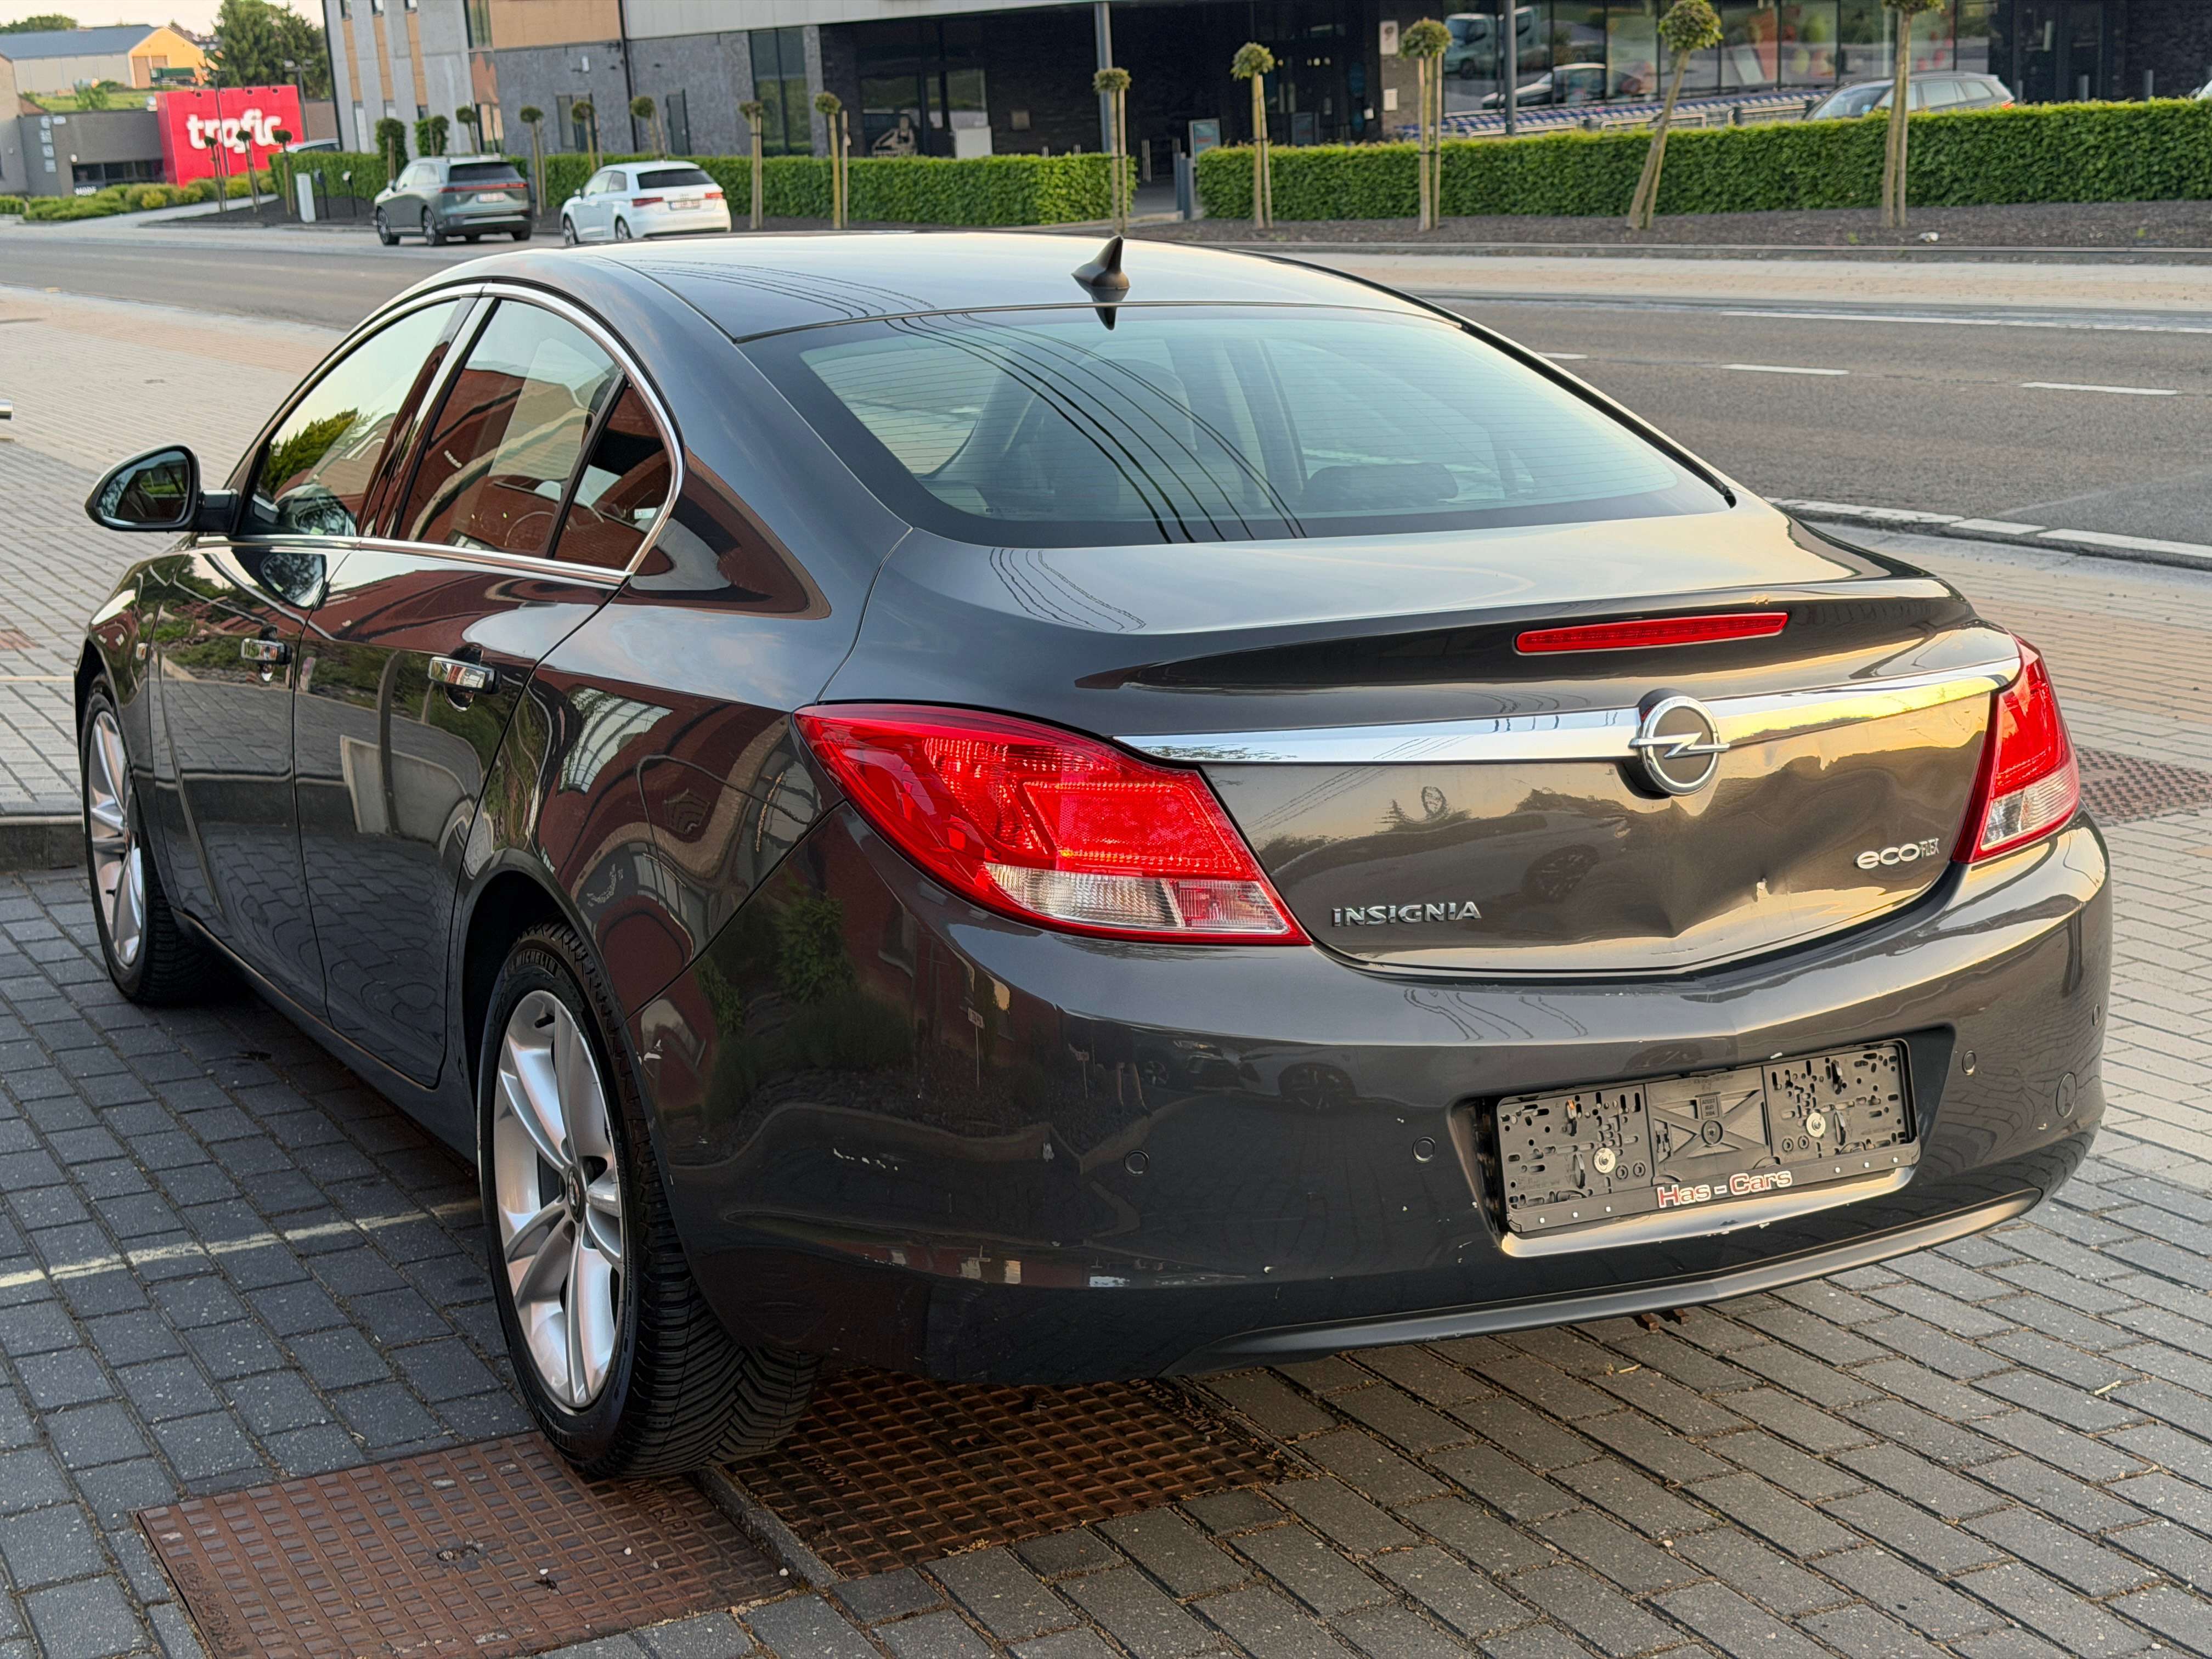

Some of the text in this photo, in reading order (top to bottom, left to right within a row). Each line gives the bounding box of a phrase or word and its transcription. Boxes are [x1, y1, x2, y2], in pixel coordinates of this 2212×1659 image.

[186, 108, 281, 154] trafic
[1332, 901, 1482, 927] INSIGNIA
[516, 950, 556, 973] MICHELIN
